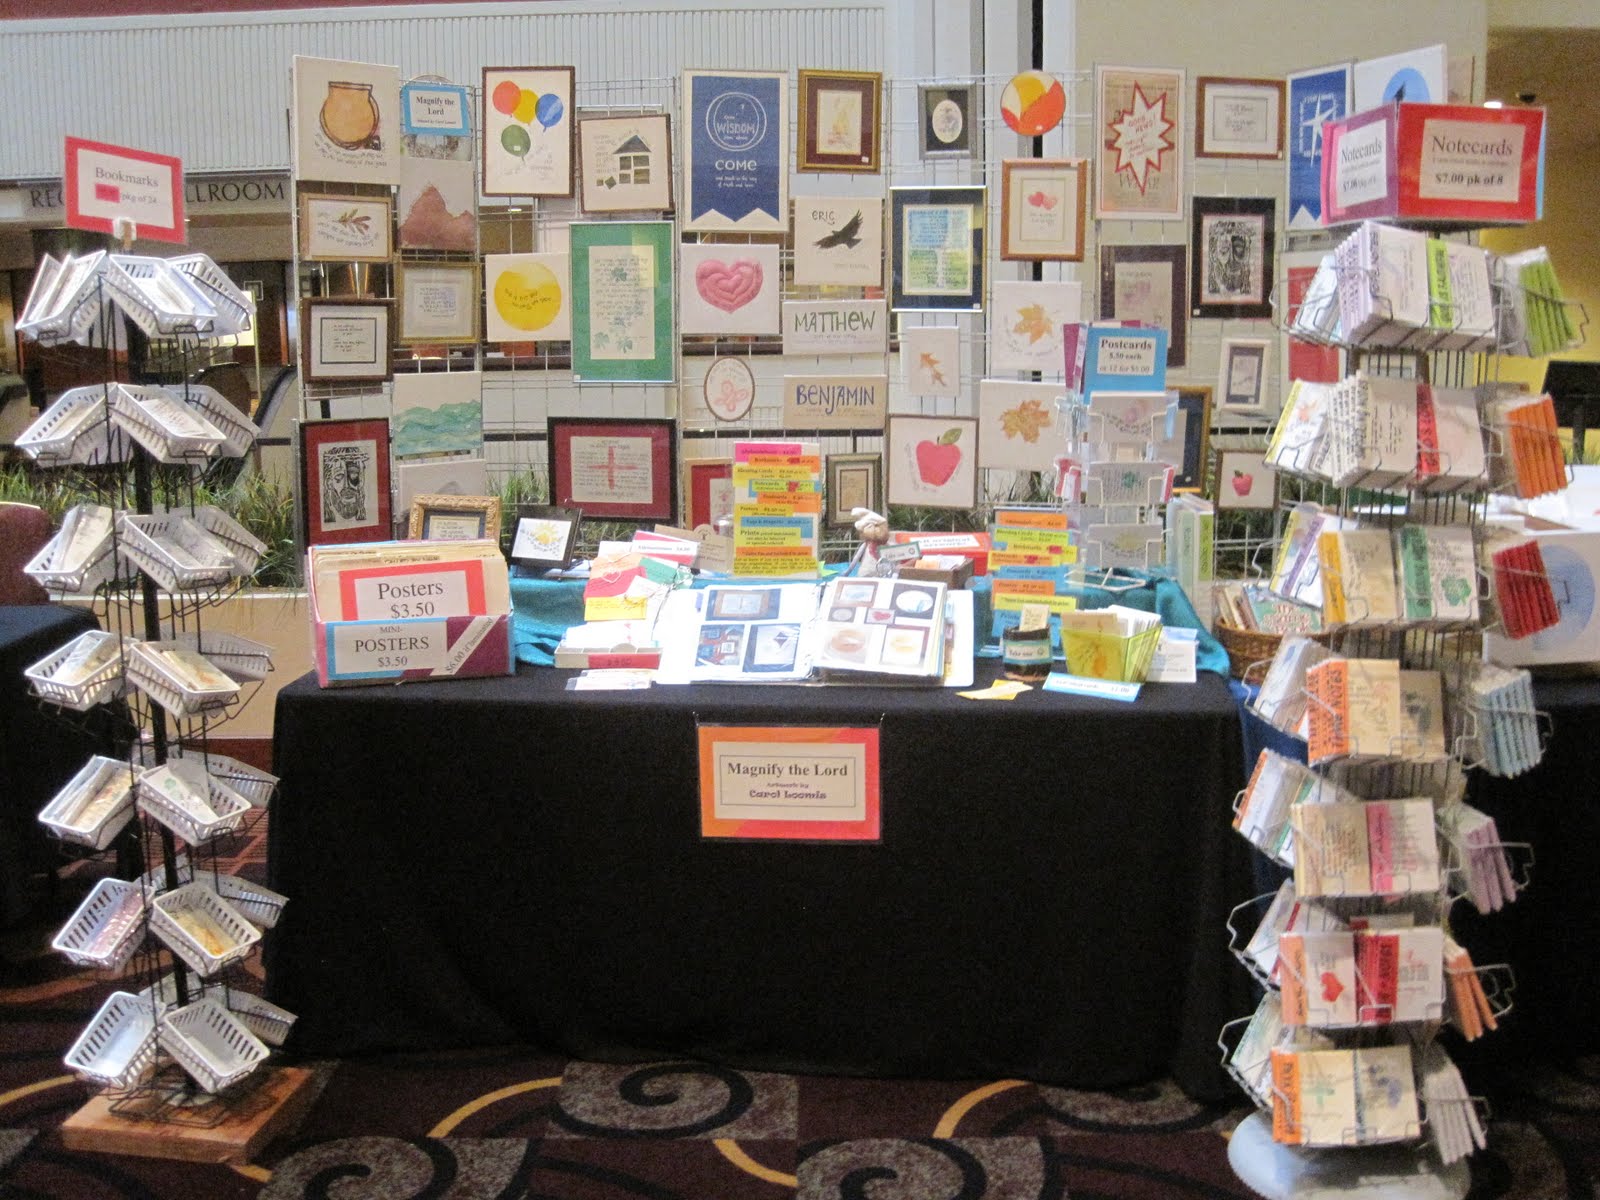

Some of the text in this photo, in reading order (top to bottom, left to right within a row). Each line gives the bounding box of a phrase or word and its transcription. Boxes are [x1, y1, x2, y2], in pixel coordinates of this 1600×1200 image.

[428, 107, 444, 115] Lord
[1342, 136, 1382, 163] Notecards
[1432, 136, 1513, 156] Notecards
[95, 167, 159, 188] Bookmarks
[1436, 173, 1464, 186] $7.00
[1467, 174, 1480, 188] pk
[1483, 174, 1494, 185] of
[1101, 339, 1152, 350] Postcards
[378, 582, 444, 600] Posters
[390, 602, 435, 619] $3.50
[355, 636, 430, 652] POSTERS
[378, 656, 408, 668] $3.50
[728, 762, 848, 778] Magnify the Lord
[750, 789, 827, 800] Carol Loomis
